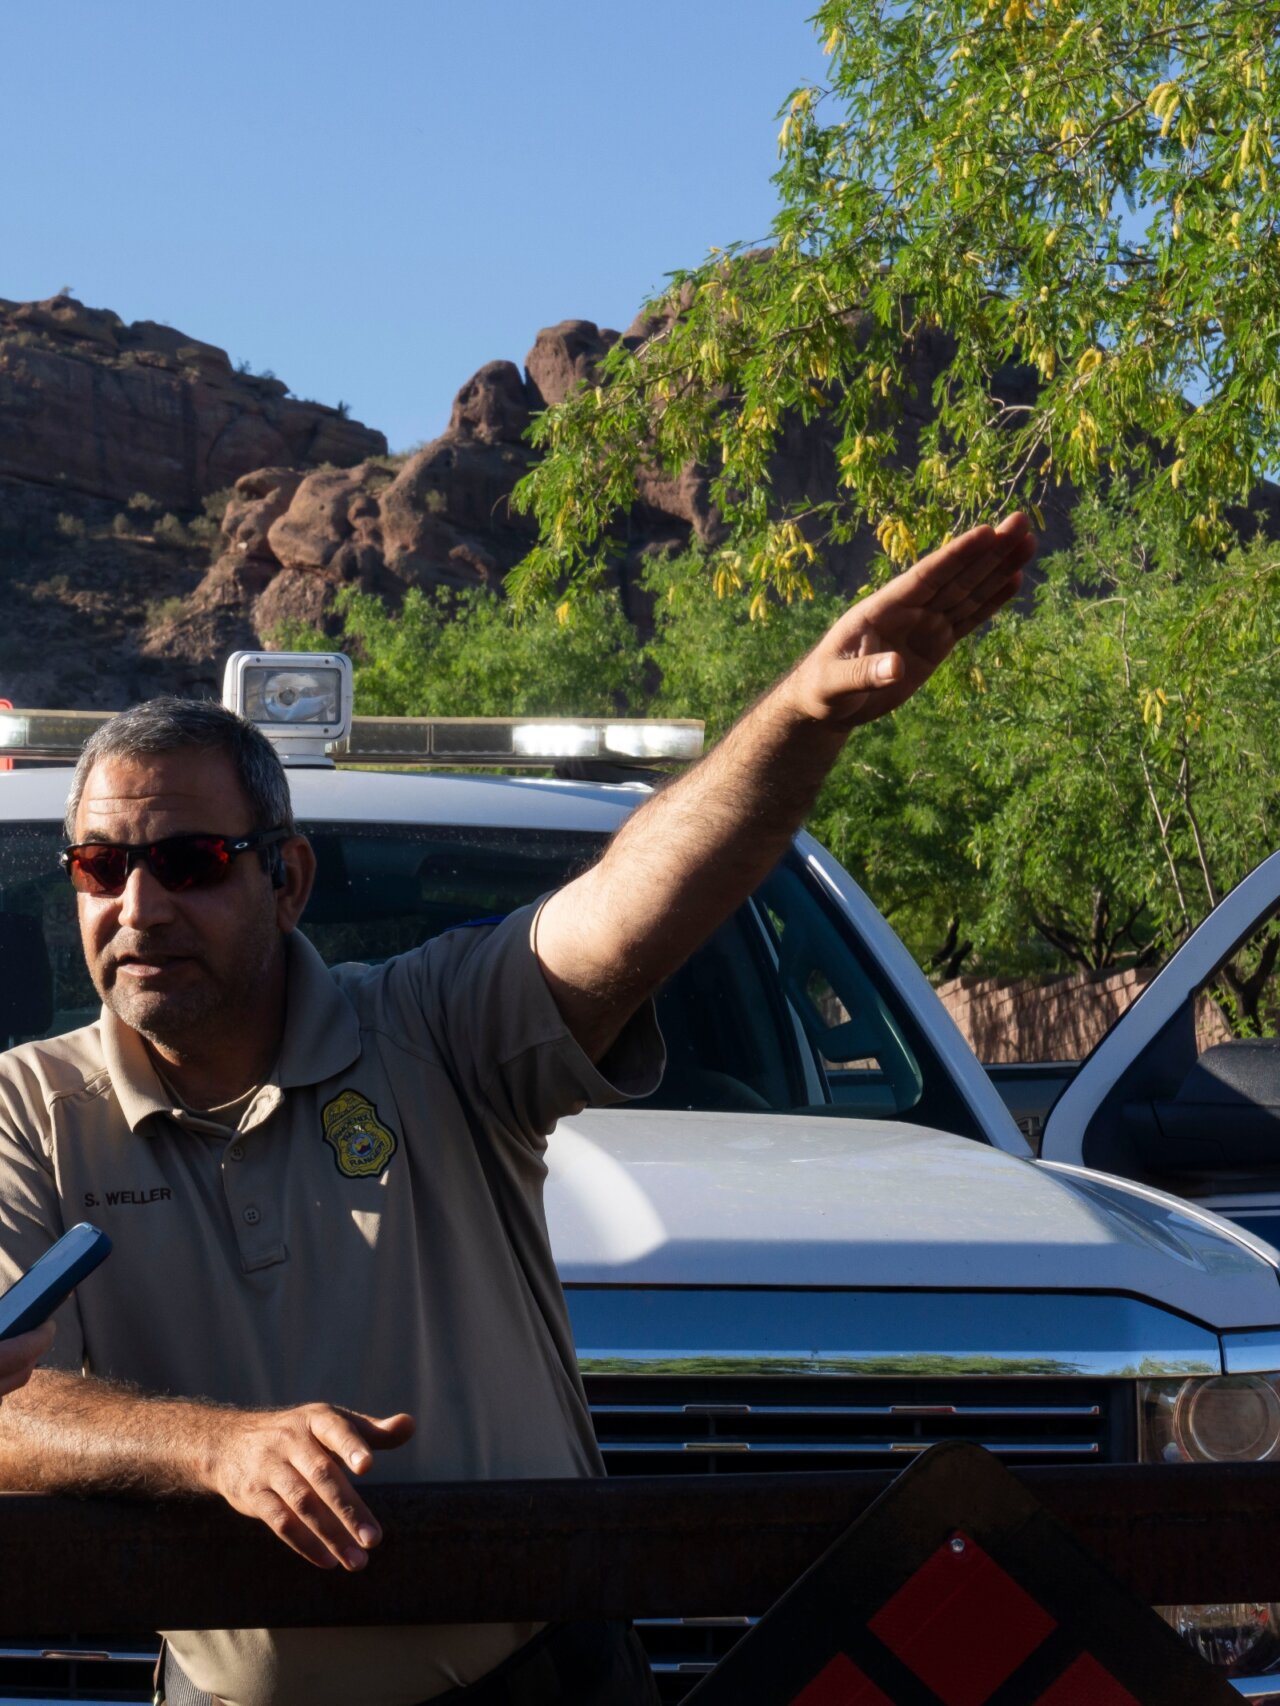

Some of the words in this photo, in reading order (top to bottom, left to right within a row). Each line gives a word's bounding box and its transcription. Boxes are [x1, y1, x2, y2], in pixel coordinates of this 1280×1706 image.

[349, 1141, 384, 1165] RANGER
[84, 1192, 100, 1208] S.
[105, 1187, 172, 1206] WELLER
